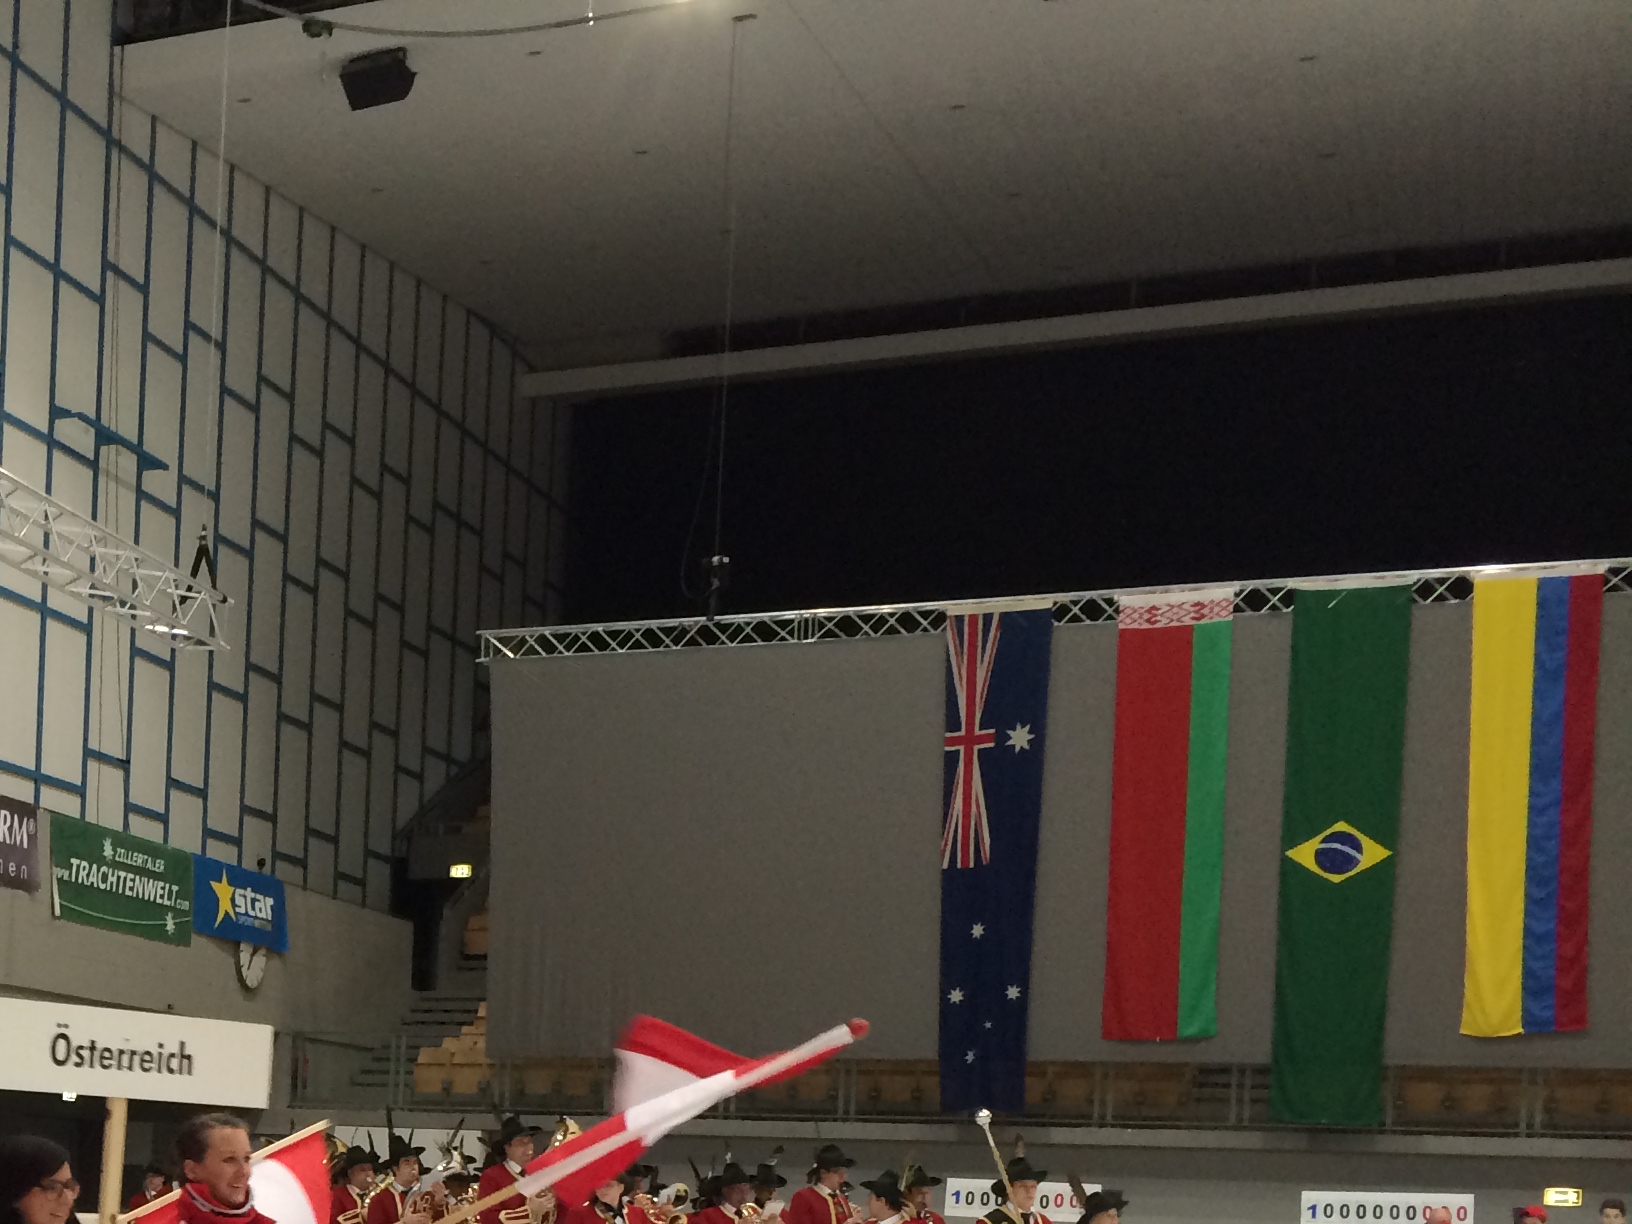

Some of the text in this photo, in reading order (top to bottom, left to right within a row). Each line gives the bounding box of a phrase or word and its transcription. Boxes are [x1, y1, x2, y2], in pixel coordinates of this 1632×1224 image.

[115, 847, 165, 873] ZILLERTALER
[235, 888, 274, 921] star
[49, 1022, 194, 1076] Österreich
